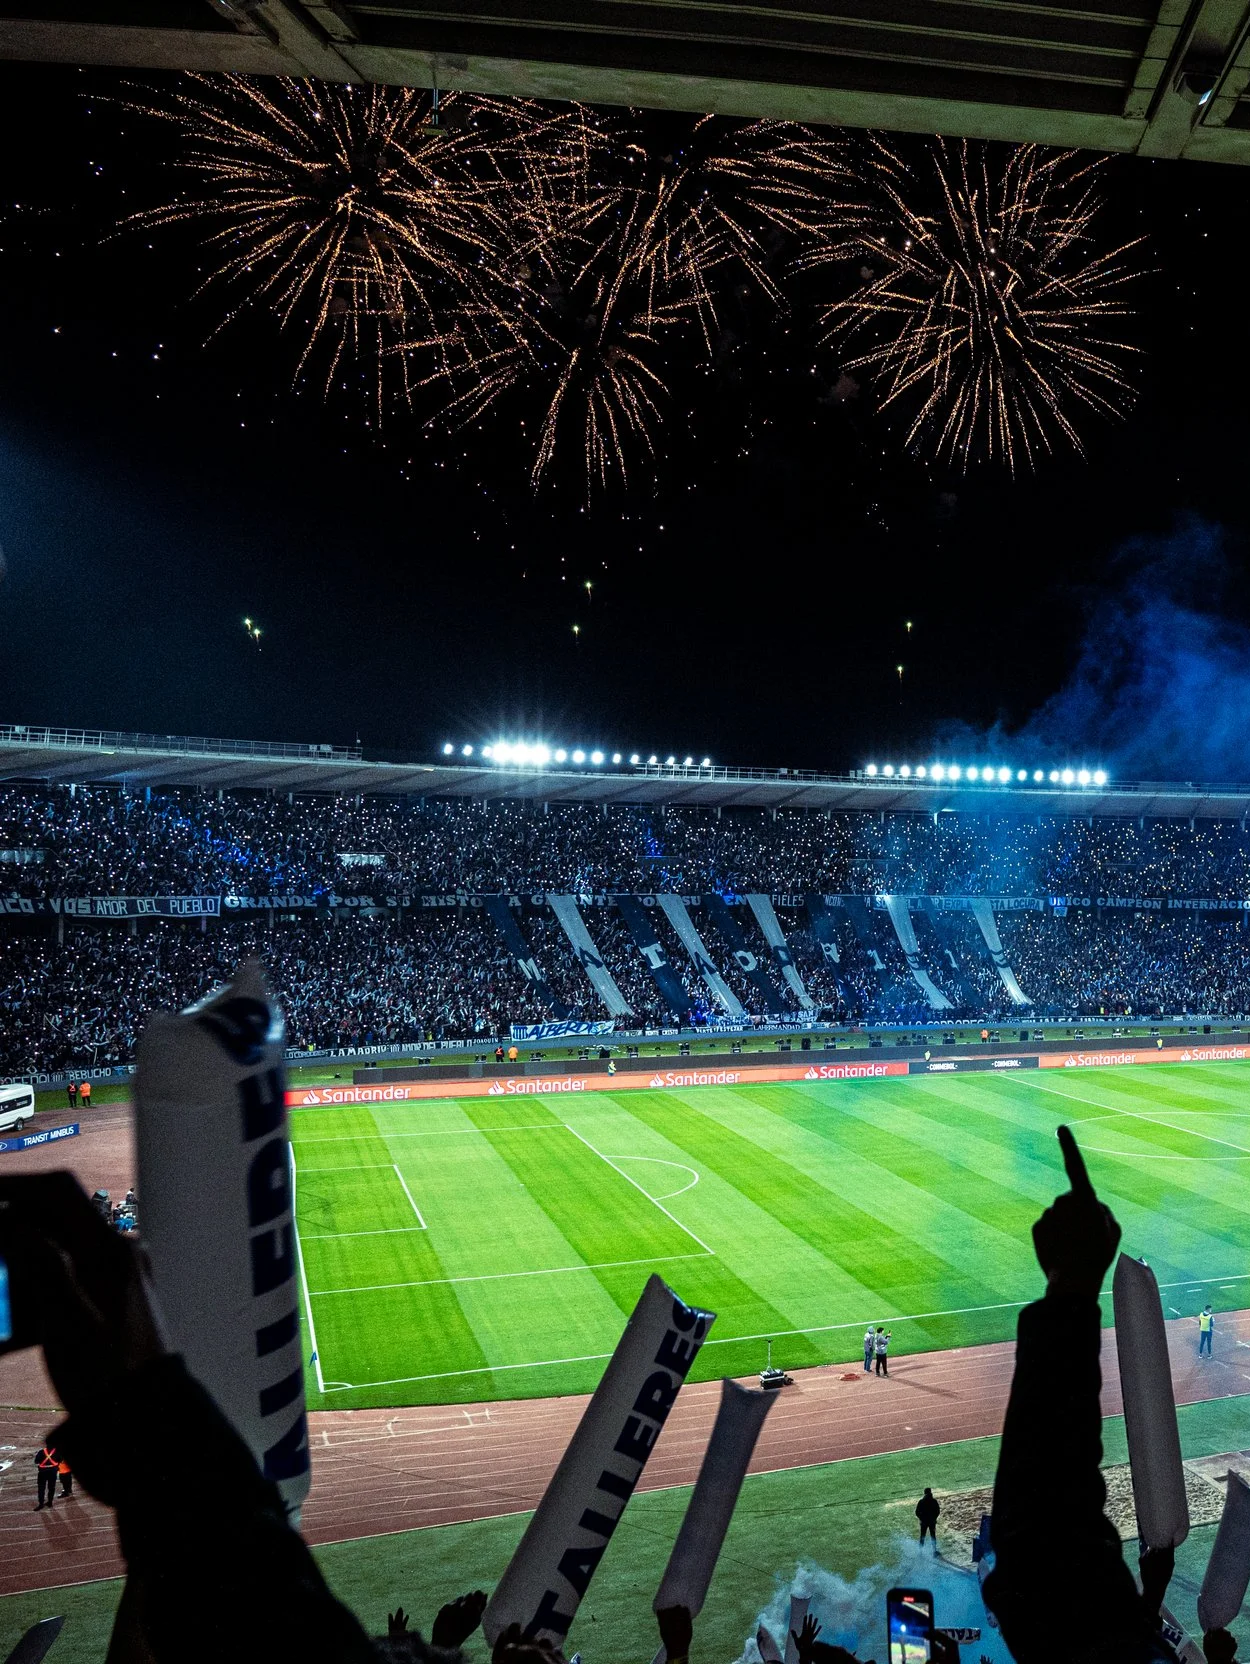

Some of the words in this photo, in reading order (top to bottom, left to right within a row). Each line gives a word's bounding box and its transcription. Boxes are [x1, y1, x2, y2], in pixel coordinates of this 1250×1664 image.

[49, 898, 91, 914] VOS
[96, 900, 128, 914] AMOR
[137, 900, 161, 912] DEL
[170, 899, 215, 913] PUEBLO
[224, 896, 317, 908] GRANDE
[328, 897, 376, 907] POR
[771, 894, 804, 907] FIELES
[1049, 896, 1091, 906] UNICO
[1097, 897, 1162, 908] CAMPEON
[1078, 1053, 1136, 1066] Santander
[1192, 1048, 1246, 1061] Santander
[69, 1067, 111, 1080] BEBUCHO
[820, 1063, 888, 1078] Santander
[507, 1077, 587, 1094] Santander
[665, 1071, 740, 1087] Santander
[322, 1085, 411, 1104] Santander
[23, 1132, 50, 1146] TRANSIT
[50, 1126, 74, 1139] MINIBUS
